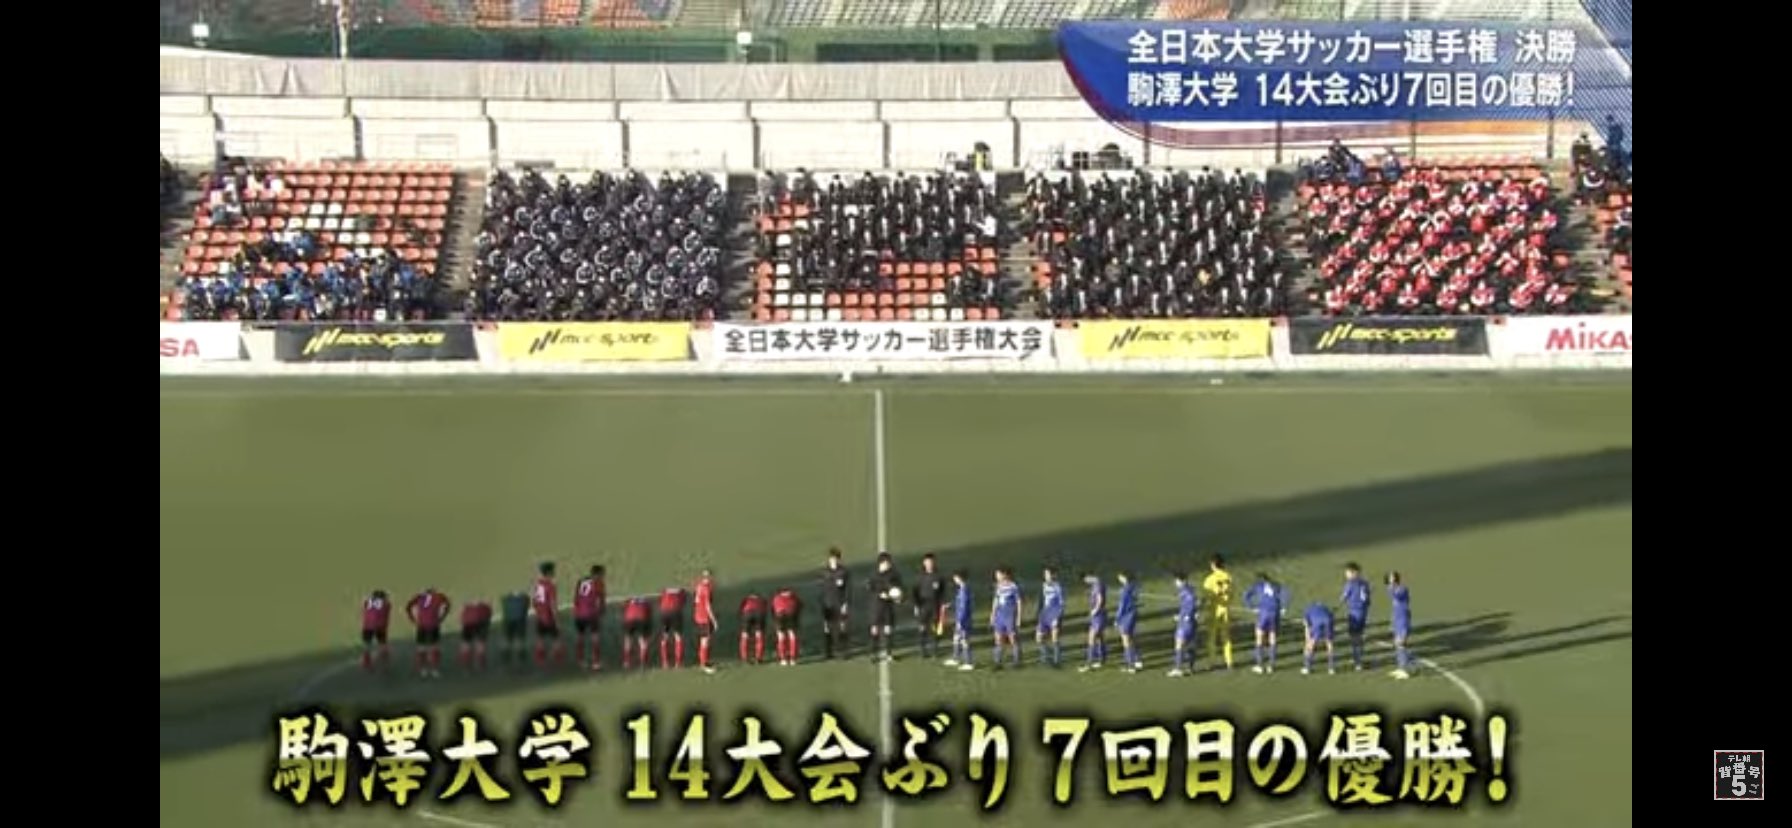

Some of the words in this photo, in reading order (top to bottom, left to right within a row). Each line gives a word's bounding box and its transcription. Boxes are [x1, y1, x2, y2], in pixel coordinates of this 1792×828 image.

[724, 326, 1043, 353] 全日本大学サッカー選手権大会
[1545, 321, 1632, 350] MiKA
